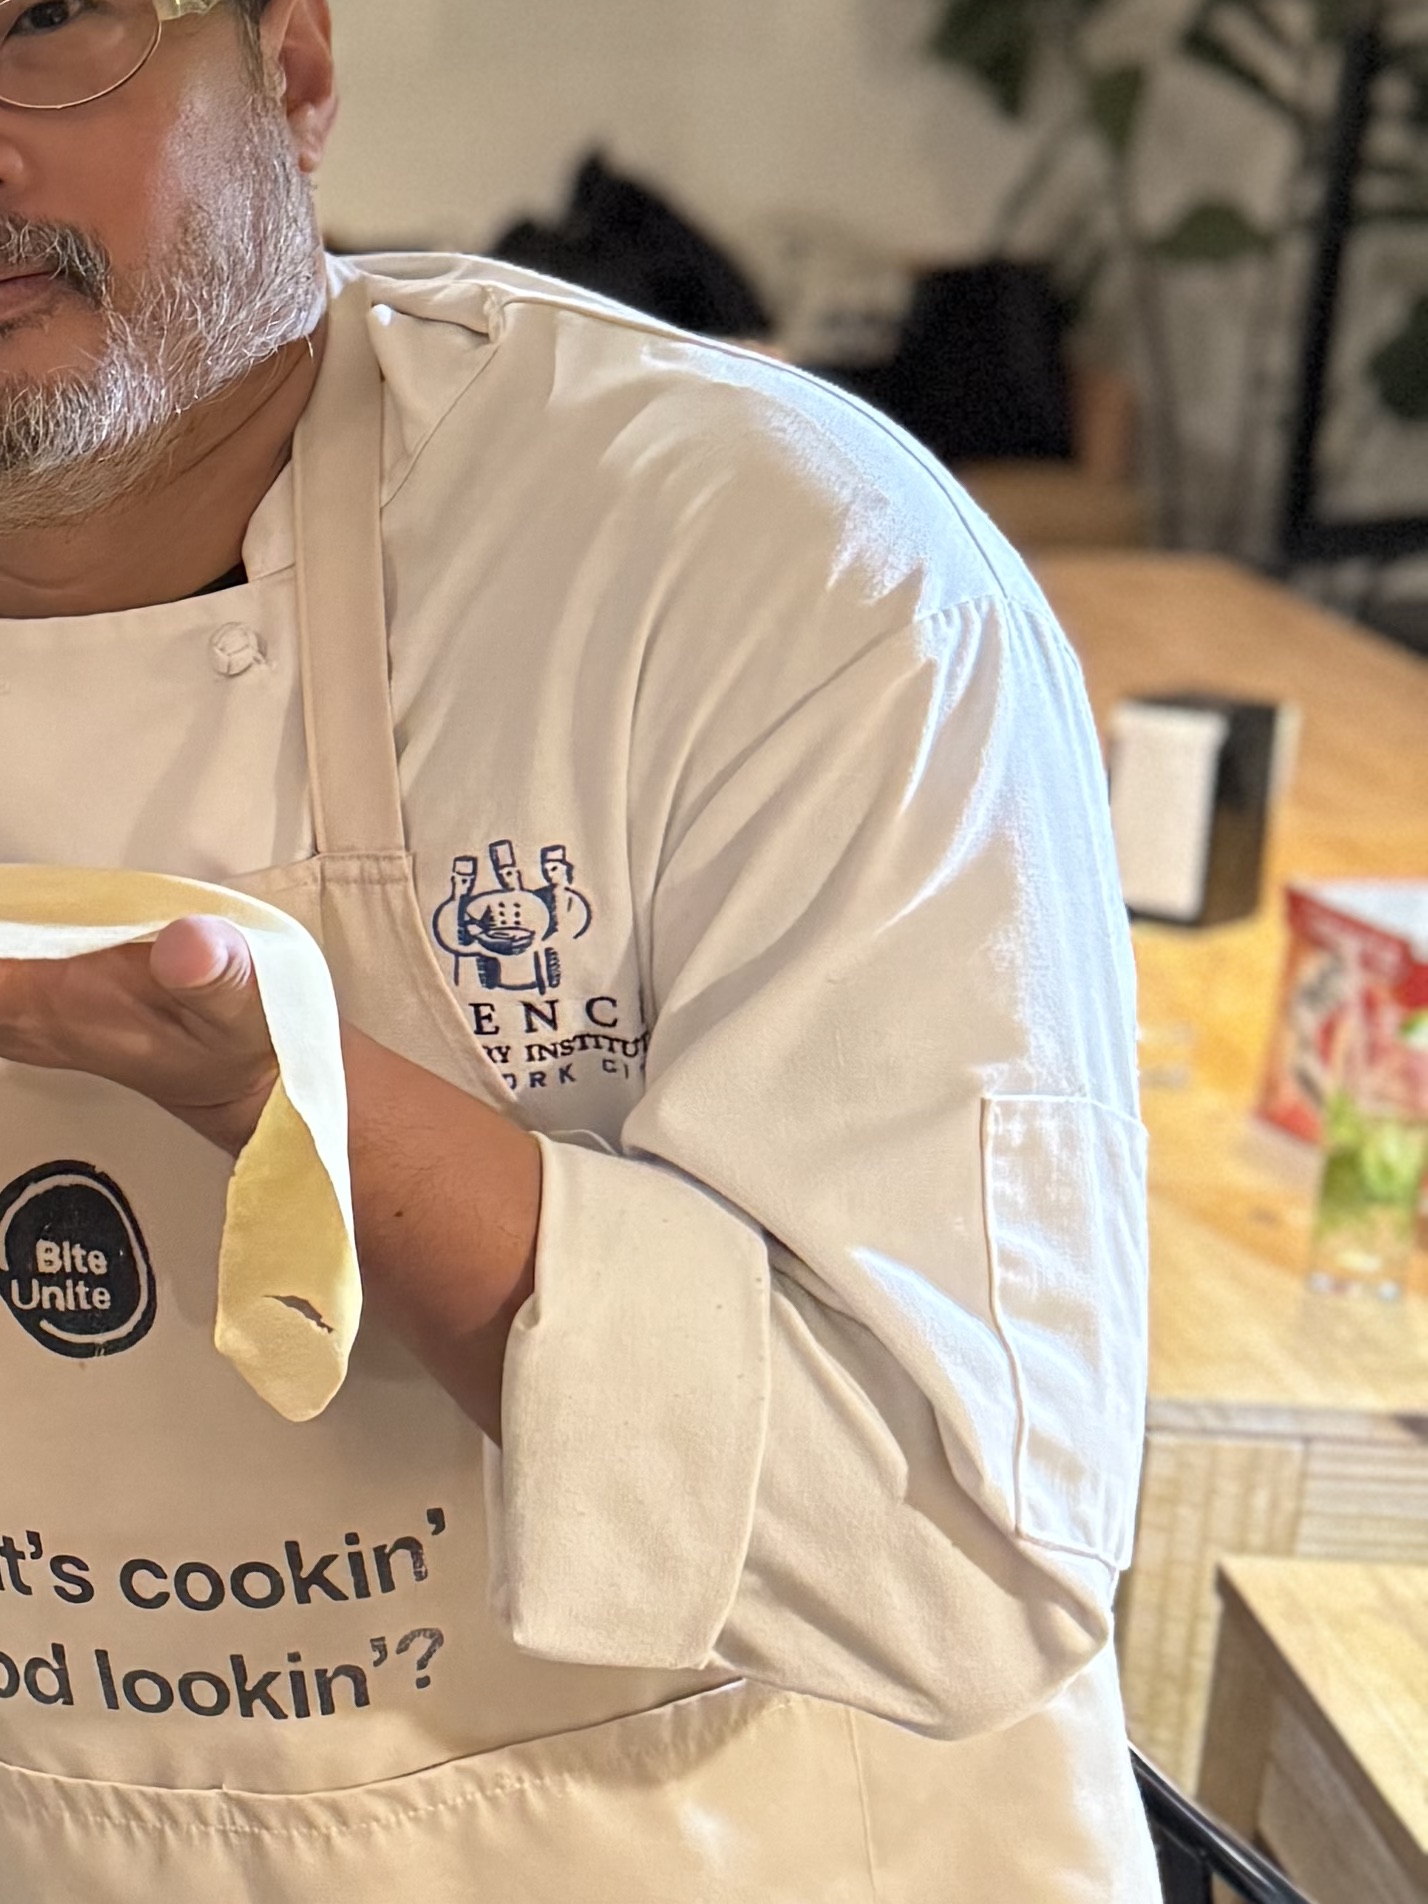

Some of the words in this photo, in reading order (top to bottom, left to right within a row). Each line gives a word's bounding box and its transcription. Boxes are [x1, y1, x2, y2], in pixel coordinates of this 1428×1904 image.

[469, 996, 619, 1035] ENC
[504, 1063, 577, 1090] ORK
[35, 1238, 108, 1275] Bite
[11, 1278, 111, 1311] Unite
[119, 1506, 446, 1611] cookin'
[94, 1627, 445, 1720] lookin'?
